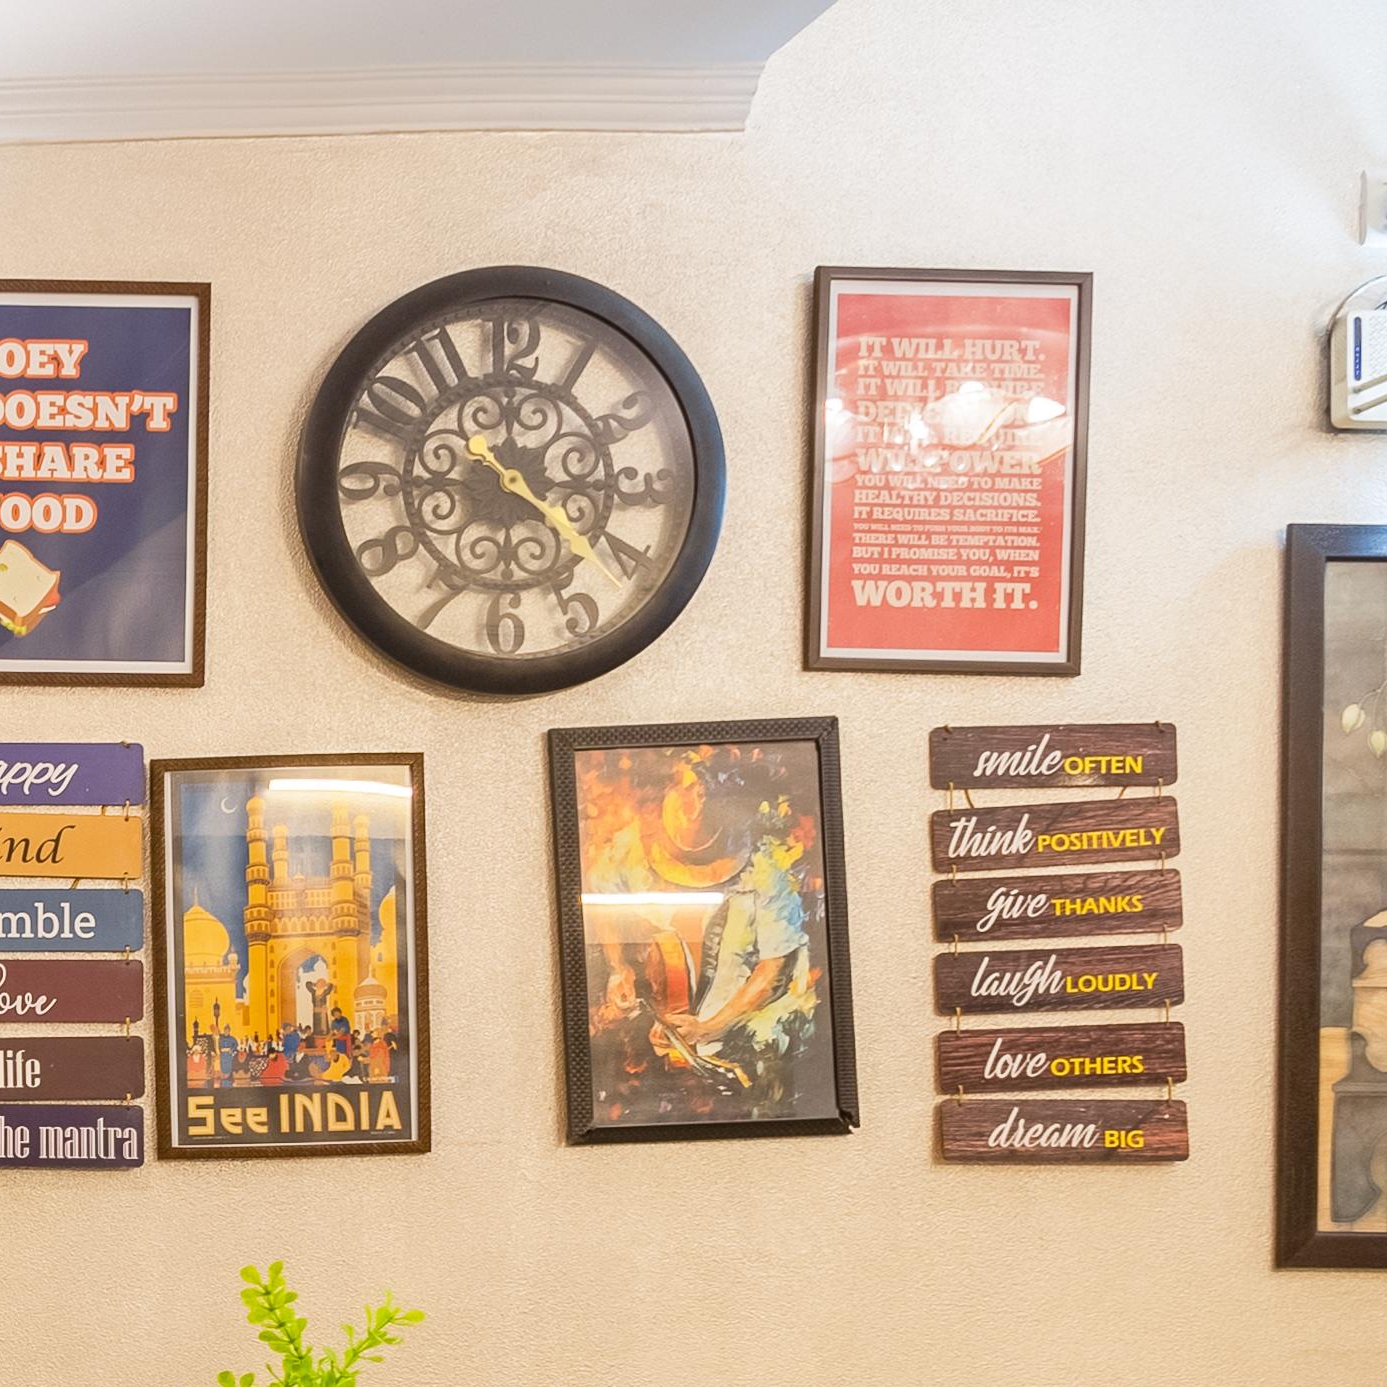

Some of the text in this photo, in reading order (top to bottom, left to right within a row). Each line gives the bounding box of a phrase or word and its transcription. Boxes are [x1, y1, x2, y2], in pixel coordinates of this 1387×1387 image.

[483, 316, 540, 382] 12
[564, 339, 600, 396] 1
[858, 337, 1046, 361] IT WILL HURT.
[858, 360, 1045, 378] IT WILL TAKE TIME.
[857, 378, 882, 395] IT
[885, 379, 941, 397] WILL
[353, 376, 426, 448] 10
[595, 390, 653, 446] 2
[338, 461, 403, 501] 9
[614, 467, 678, 505] 3
[854, 490, 1042, 507] HEALTHY DECISIONS.
[855, 475, 885, 486] YOU
[888, 475, 925, 488] WILL
[971, 477, 992, 488] TO
[995, 478, 1042, 490] MAKE
[853, 507, 1041, 522] IT REQUIRES SACRIFICE.
[356, 526, 420, 577] 8
[852, 547, 1039, 562] BUT I PROMISE YOU, WHEN
[853, 533, 1041, 546] THERE WILL BE TEMPTATION.
[852, 563, 879, 575] YOU
[882, 564, 928, 575] REACH
[930, 565, 967, 576] YOUR
[970, 566, 1012, 579] GOAL,
[851, 580, 1039, 609] WORTH IT.
[486, 592, 526, 654] 6
[973, 734, 1143, 777] smile OFTEN
[947, 814, 1166, 858] think POSITIVELY
[976, 886, 1143, 933] give THANKS
[970, 954, 1159, 1006] laugh LOUDLY
[983, 1037, 1145, 1080] love OTHERS
[186, 1091, 403, 1136] See INDIA
[988, 1106, 1145, 1150] dream BIG
[38, 1120, 139, 1161] mantra
